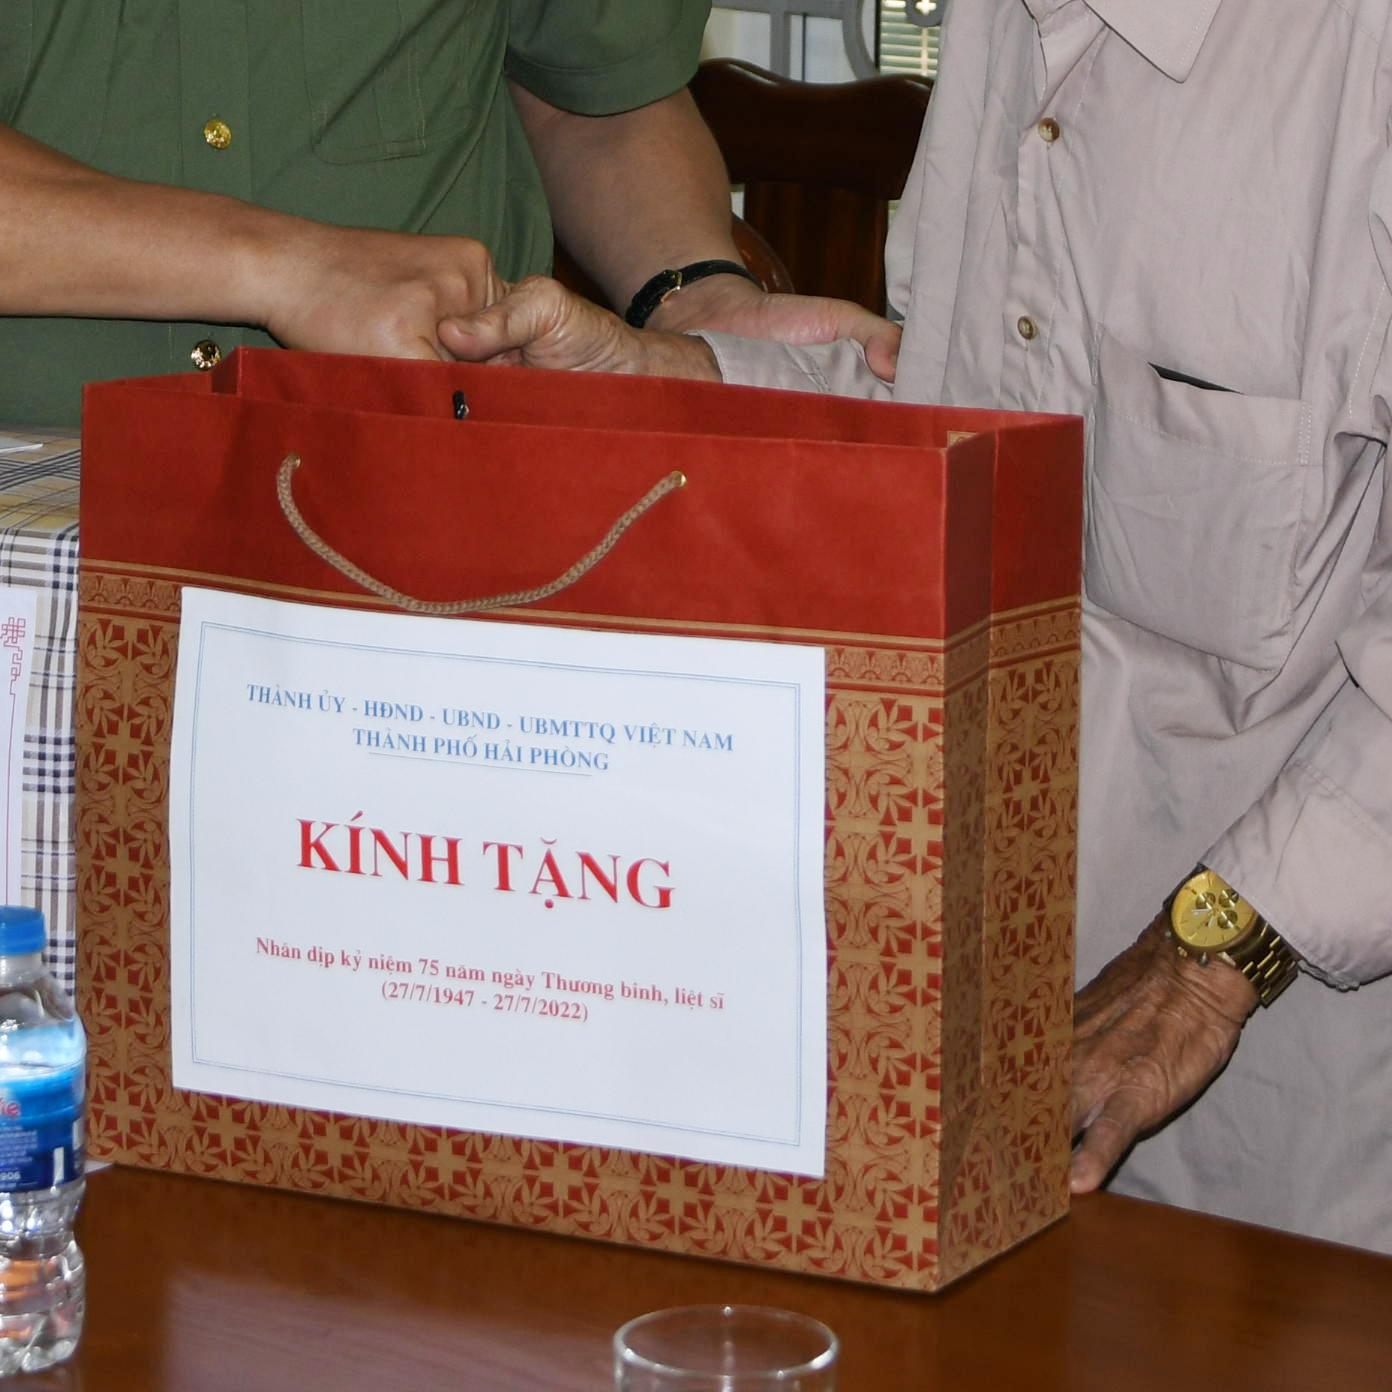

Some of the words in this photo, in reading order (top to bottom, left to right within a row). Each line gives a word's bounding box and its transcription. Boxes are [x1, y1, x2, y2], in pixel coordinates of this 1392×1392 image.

[247, 684, 312, 709] THÀNH
[318, 690, 345, 713] ỦY
[364, 700, 423, 721] HĐND
[443, 708, 501, 729] UBND
[520, 716, 616, 744] UBMTTQ
[624, 723, 676, 748] VIỆT
[683, 730, 733, 751] NAM
[353, 728, 426, 755] THÀNH
[433, 732, 477, 758] PHỐ
[484, 739, 522, 763] HẢI
[530, 746, 608, 770] PHÒNG
[296, 810, 464, 888] KÍNH
[483, 836, 675, 911] TẶNG
[256, 937, 301, 960] Nhân
[307, 946, 336, 968] dịp
[368, 954, 413, 975] niệm
[419, 958, 439, 976] 75
[492, 969, 535, 991] ngày
[541, 972, 615, 1001] Thương
[620, 981, 668, 1006] binh,
[675, 987, 703, 1010] liệt
[710, 993, 724, 1009] sĩ
[382, 981, 476, 1007] (27/7/1947
[493, 994, 588, 1023] 27/7/2022)
